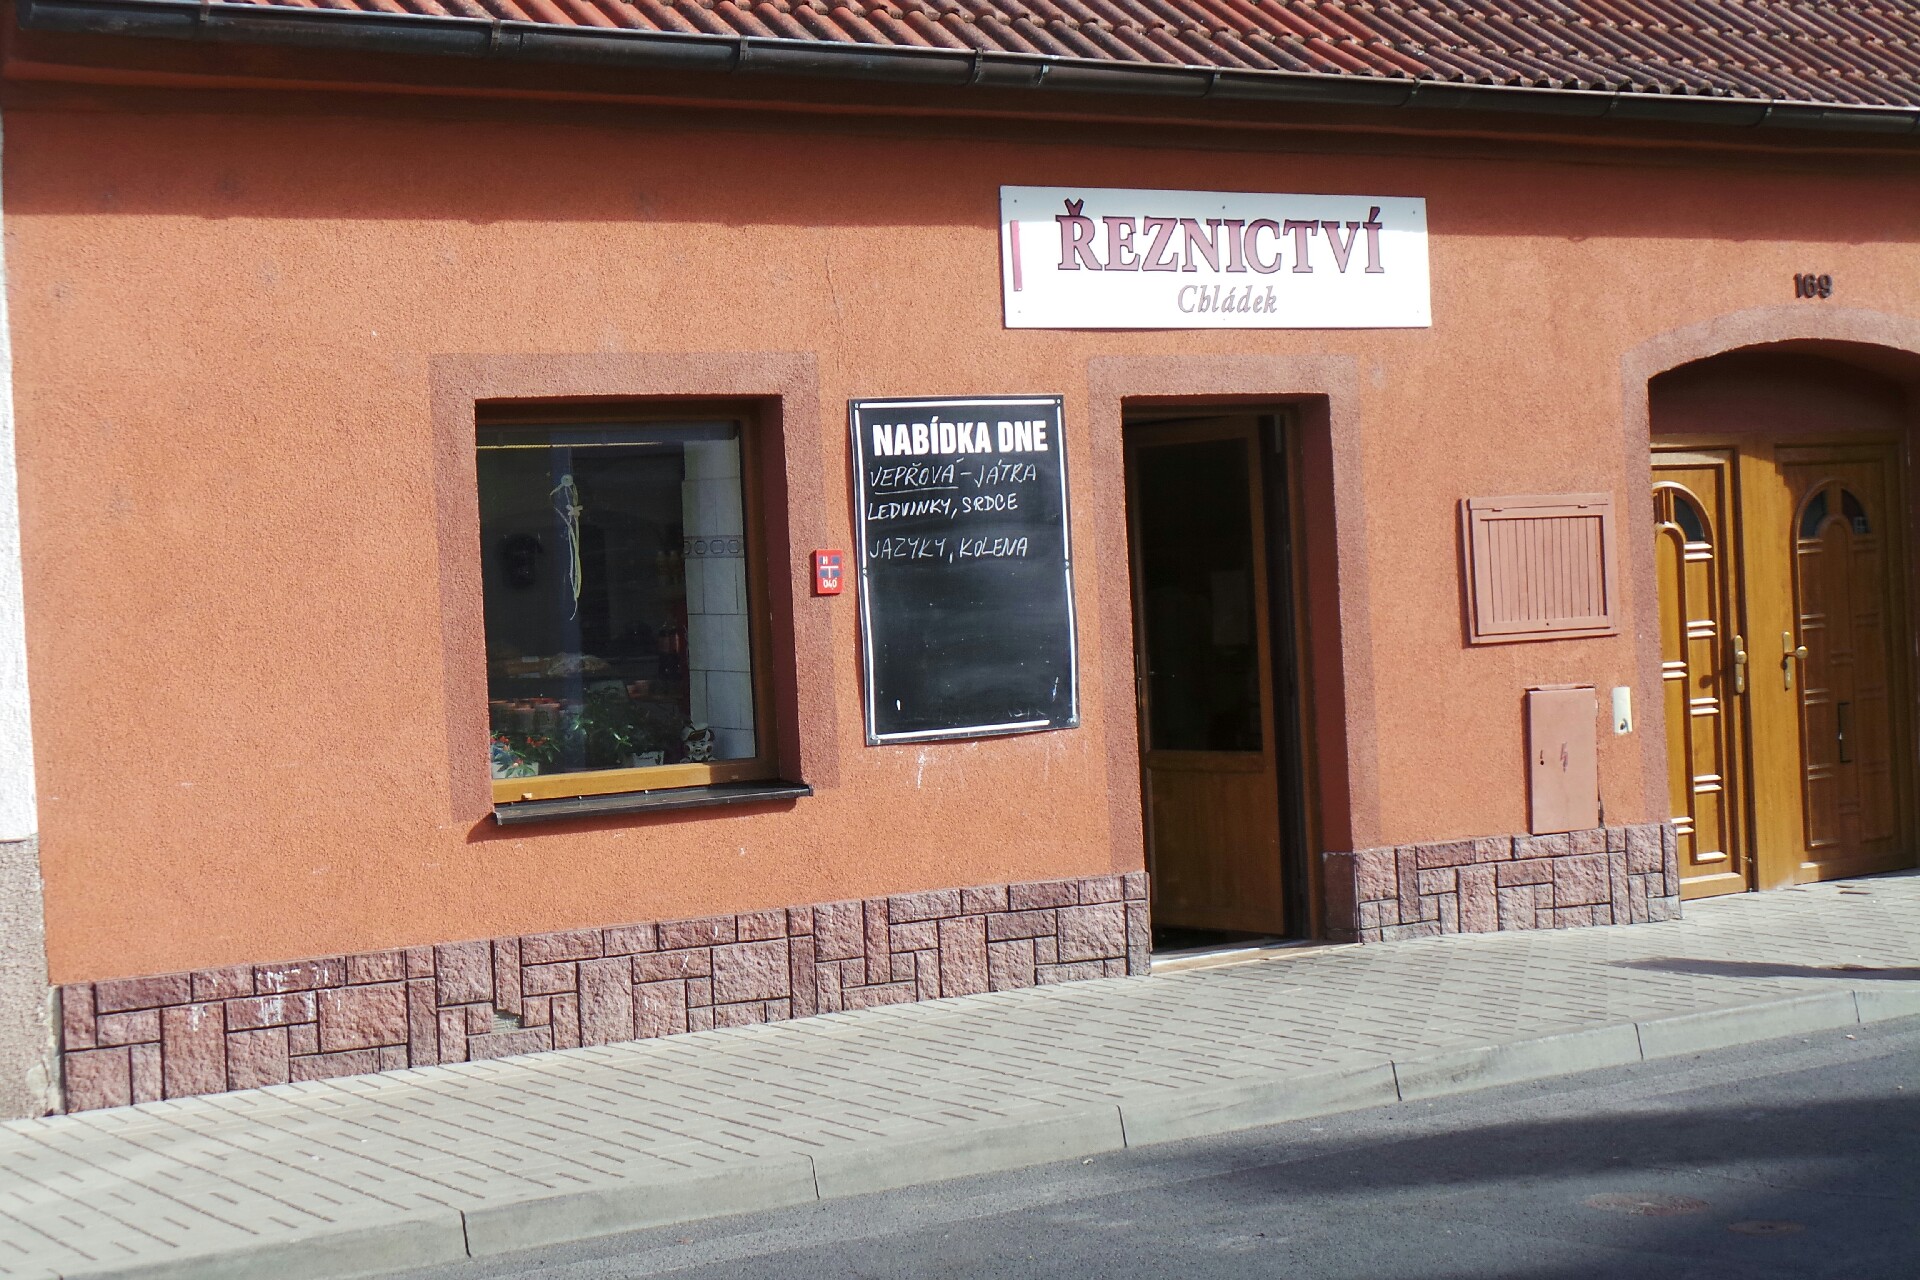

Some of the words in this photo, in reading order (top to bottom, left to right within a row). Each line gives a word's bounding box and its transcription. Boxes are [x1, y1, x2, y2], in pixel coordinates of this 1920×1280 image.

[1055, 198, 1385, 274] ŘEZNICTVÍ
[1793, 273, 1832, 299] 169
[873, 416, 992, 456] NABÍDKA
[998, 420, 1049, 452] DNE
[962, 493, 1019, 514] SRDCE
[959, 536, 1029, 558] KOLENA
